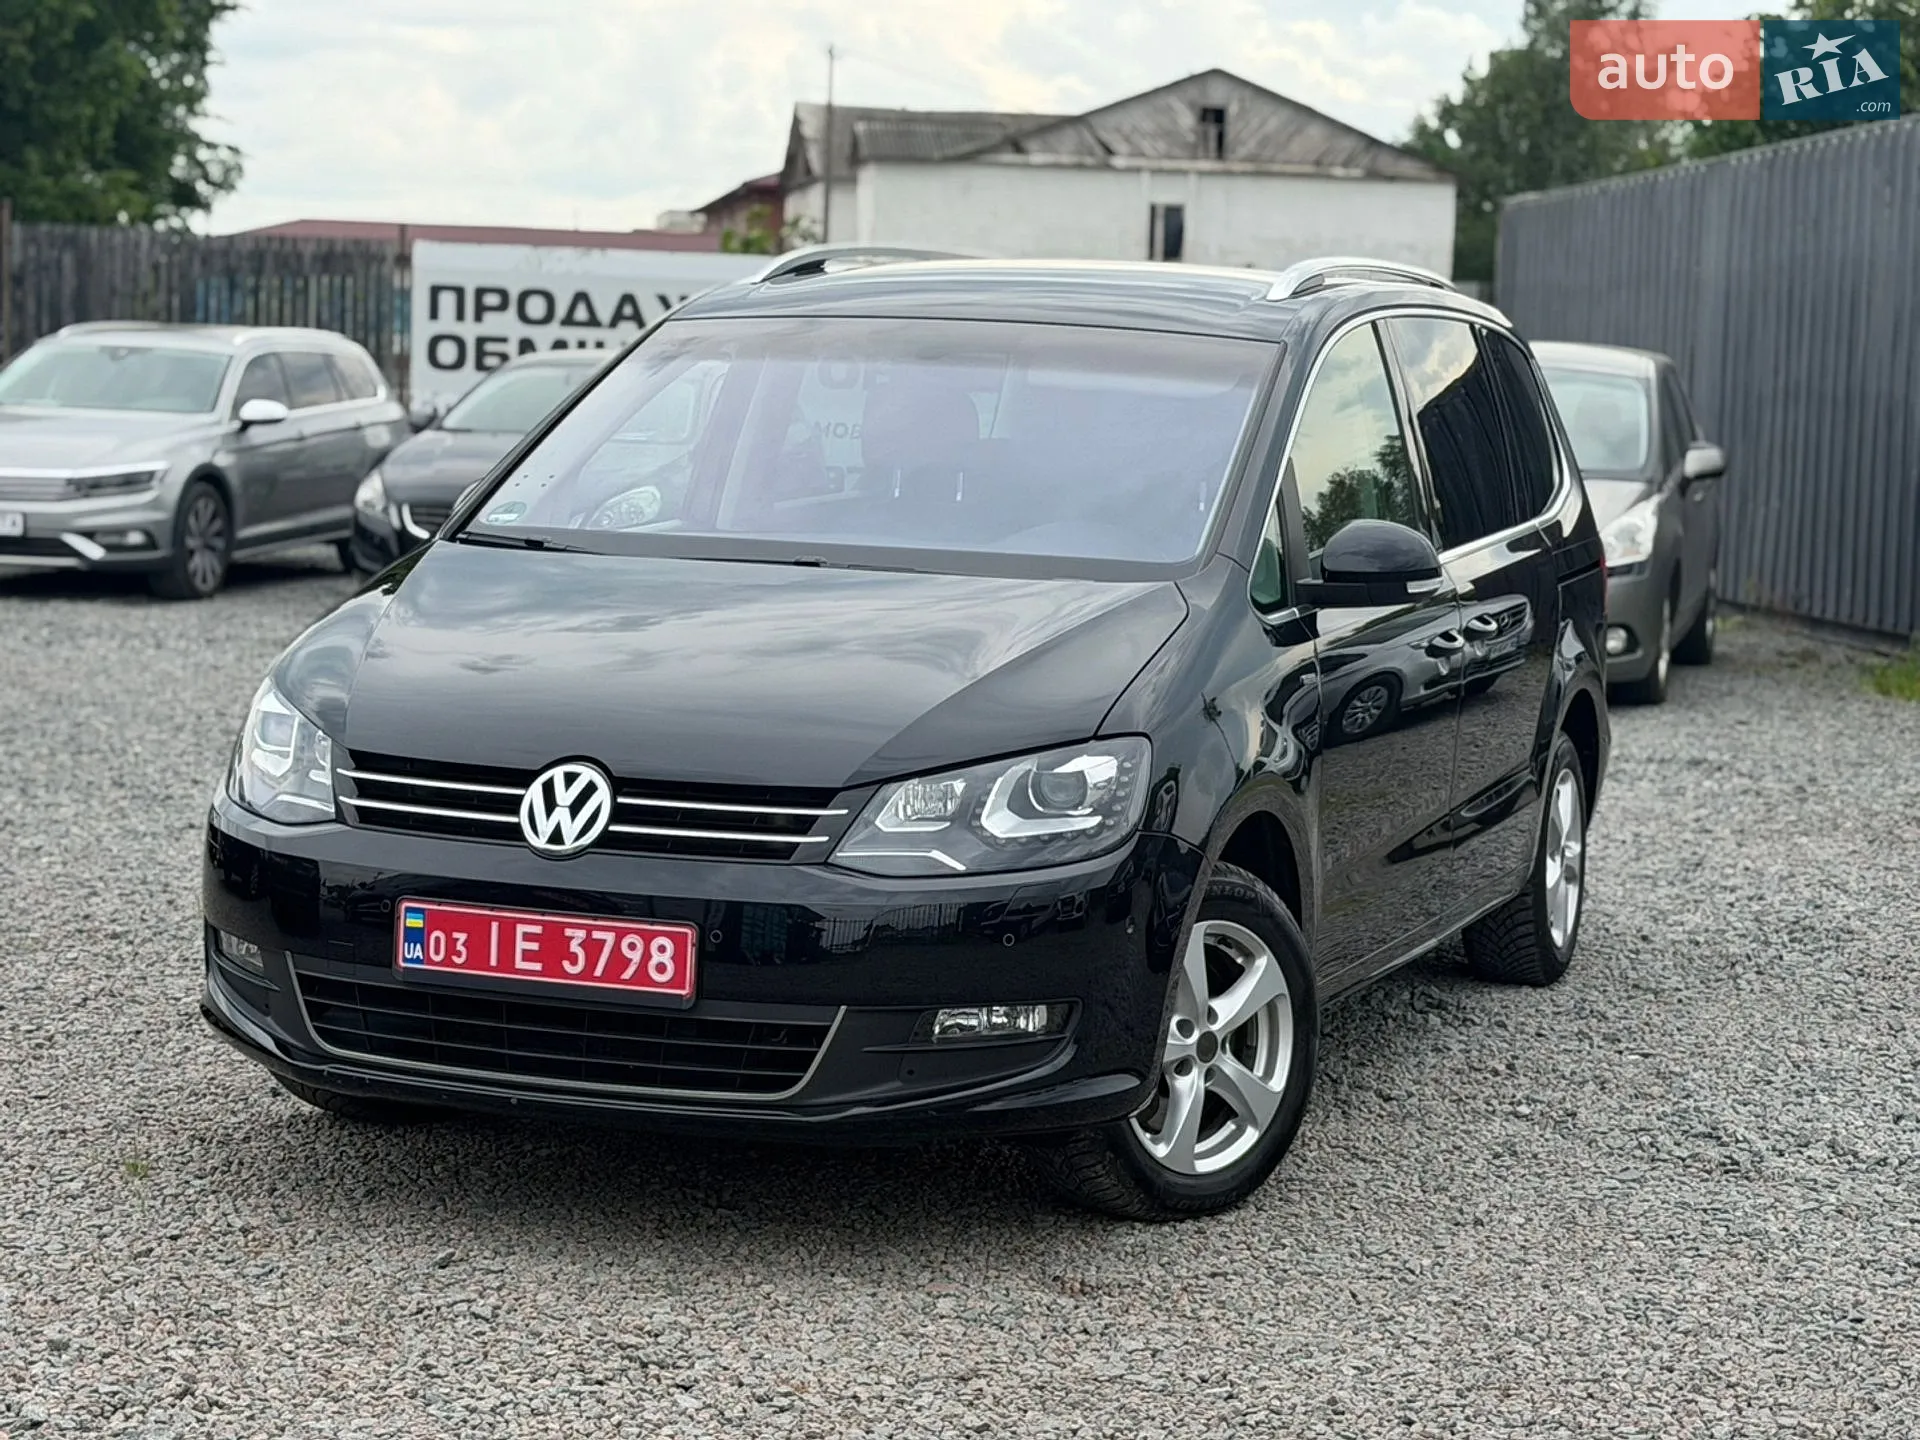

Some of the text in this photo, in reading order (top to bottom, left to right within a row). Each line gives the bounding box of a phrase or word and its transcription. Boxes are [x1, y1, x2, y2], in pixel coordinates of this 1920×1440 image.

[404, 942, 424, 960] UA
[428, 921, 675, 983] 03 IE 3798
